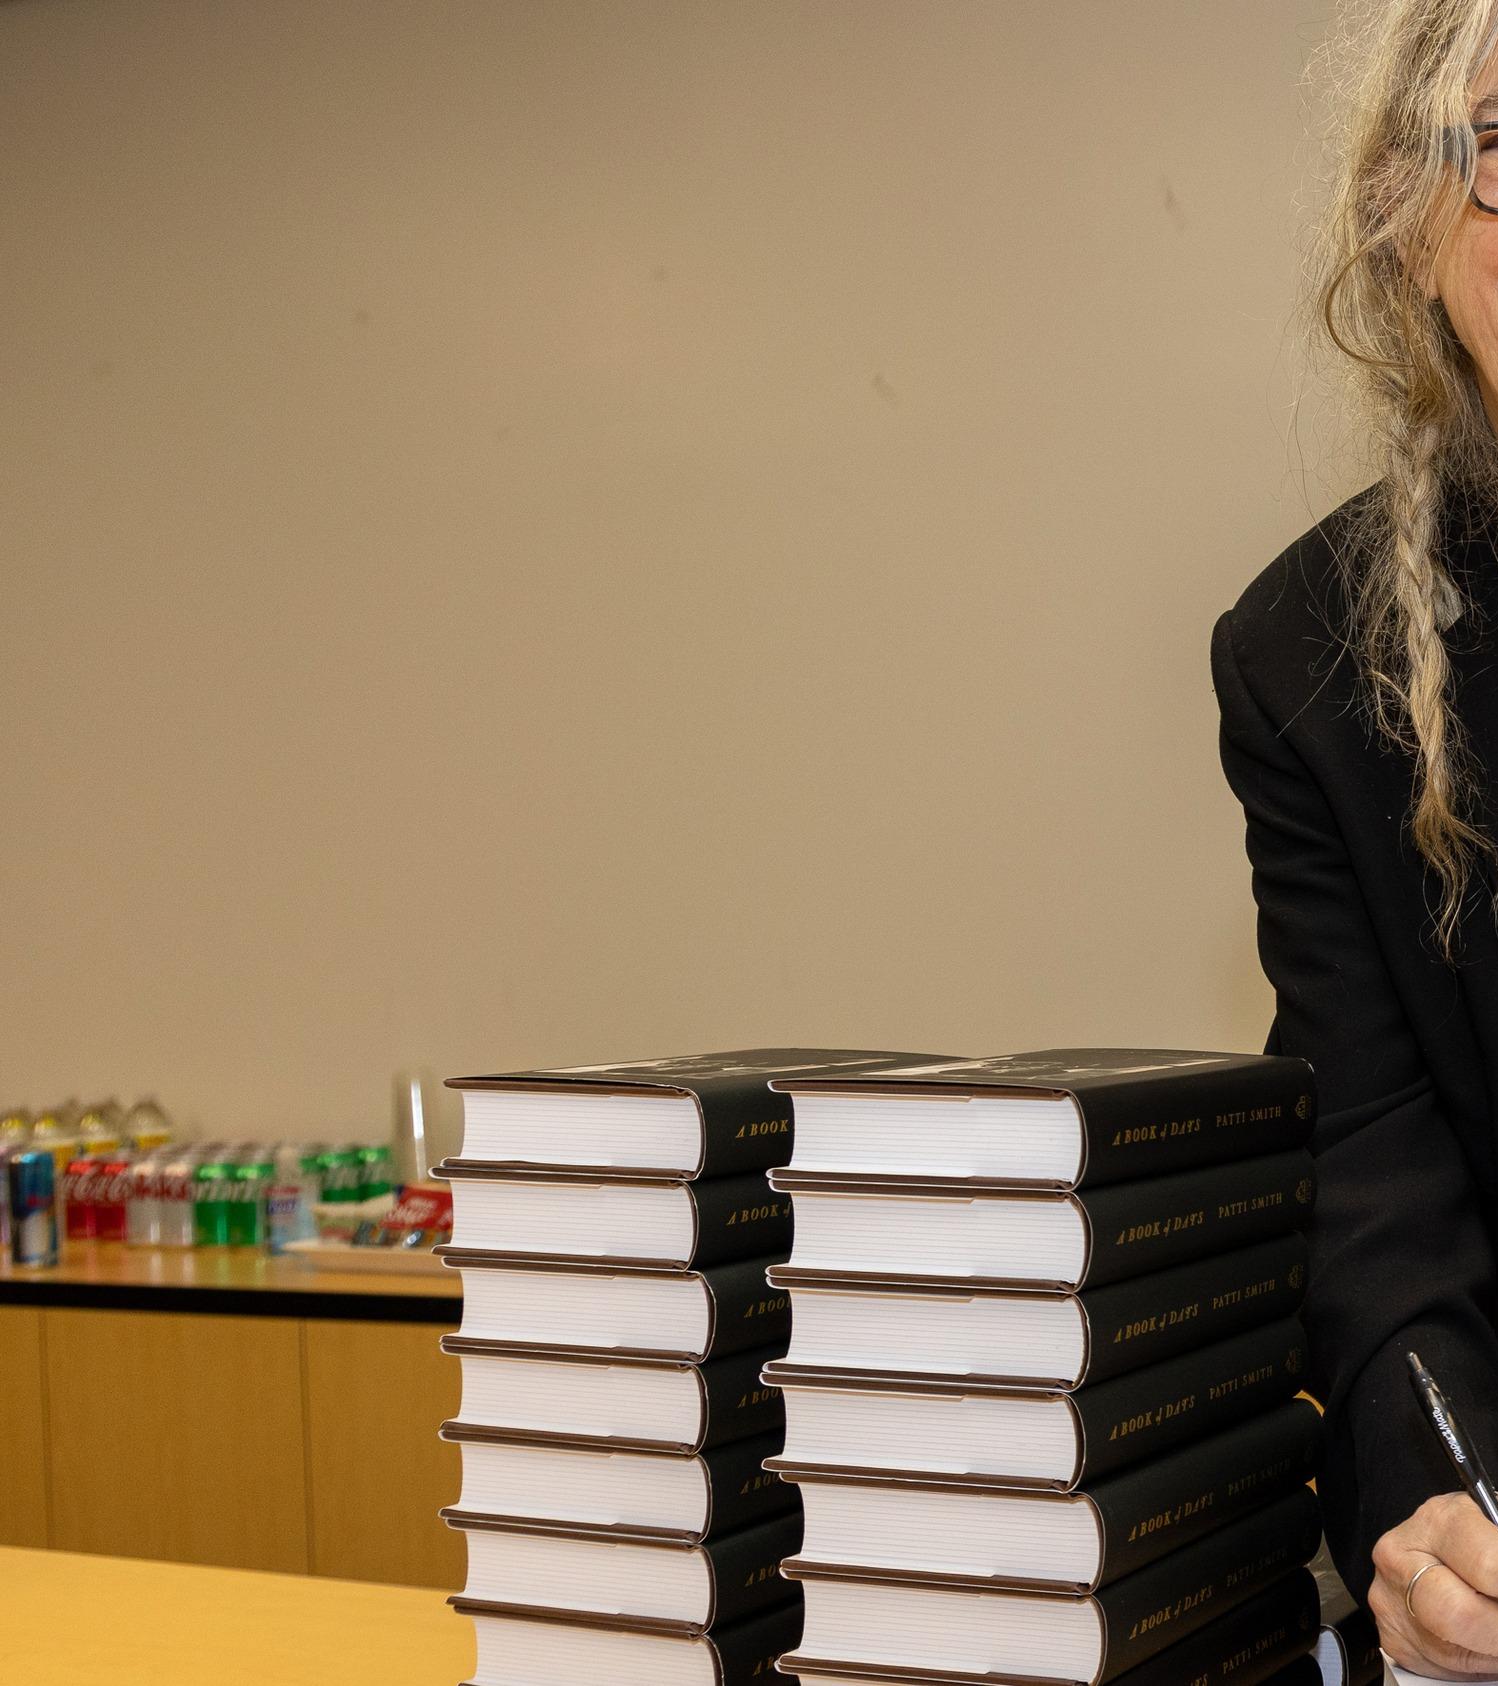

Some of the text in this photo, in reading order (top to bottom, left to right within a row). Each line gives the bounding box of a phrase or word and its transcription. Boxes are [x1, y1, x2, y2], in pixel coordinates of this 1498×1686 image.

[735, 1119, 789, 1139] A BOOK
[1112, 1131, 1121, 1146] A
[1125, 1125, 1157, 1144] BOOK
[1171, 1119, 1201, 1136] DAYS
[1216, 1113, 1246, 1127] PATTI
[1250, 1106, 1282, 1122] SMITH
[726, 1211, 737, 1225] A
[740, 1204, 778, 1222] BOOK
[1115, 1230, 1125, 1246] A
[1128, 1221, 1161, 1242] BOOK
[1173, 1210, 1206, 1231] DAYS
[1218, 1201, 1247, 1219] PATTI
[1251, 1192, 1282, 1211] SMITH
[744, 1296, 790, 1319] A BOO
[1113, 1328, 1123, 1343] A
[1125, 1317, 1156, 1340] BOOK
[1169, 1304, 1199, 1324] DAYS
[1212, 1290, 1241, 1310] PATTI
[1245, 1280, 1276, 1298] SMITH
[736, 1394, 748, 1408] A
[1109, 1425, 1118, 1441] A
[1120, 1411, 1152, 1437] BOOK
[1166, 1395, 1195, 1419] DAYS
[1209, 1379, 1238, 1400] PATTI
[1242, 1365, 1273, 1386] SMITH
[740, 1480, 750, 1495] A
[1128, 1526, 1137, 1543] A
[1140, 1510, 1172, 1537] BOOK
[1184, 1491, 1215, 1518] DAYS
[744, 1570, 755, 1587] A
[1128, 1624, 1137, 1640] A
[1140, 1606, 1172, 1635] BOOK
[1184, 1586, 1214, 1613] DAYS
[753, 1661, 762, 1676] A
[1222, 1647, 1252, 1673] PATTI
